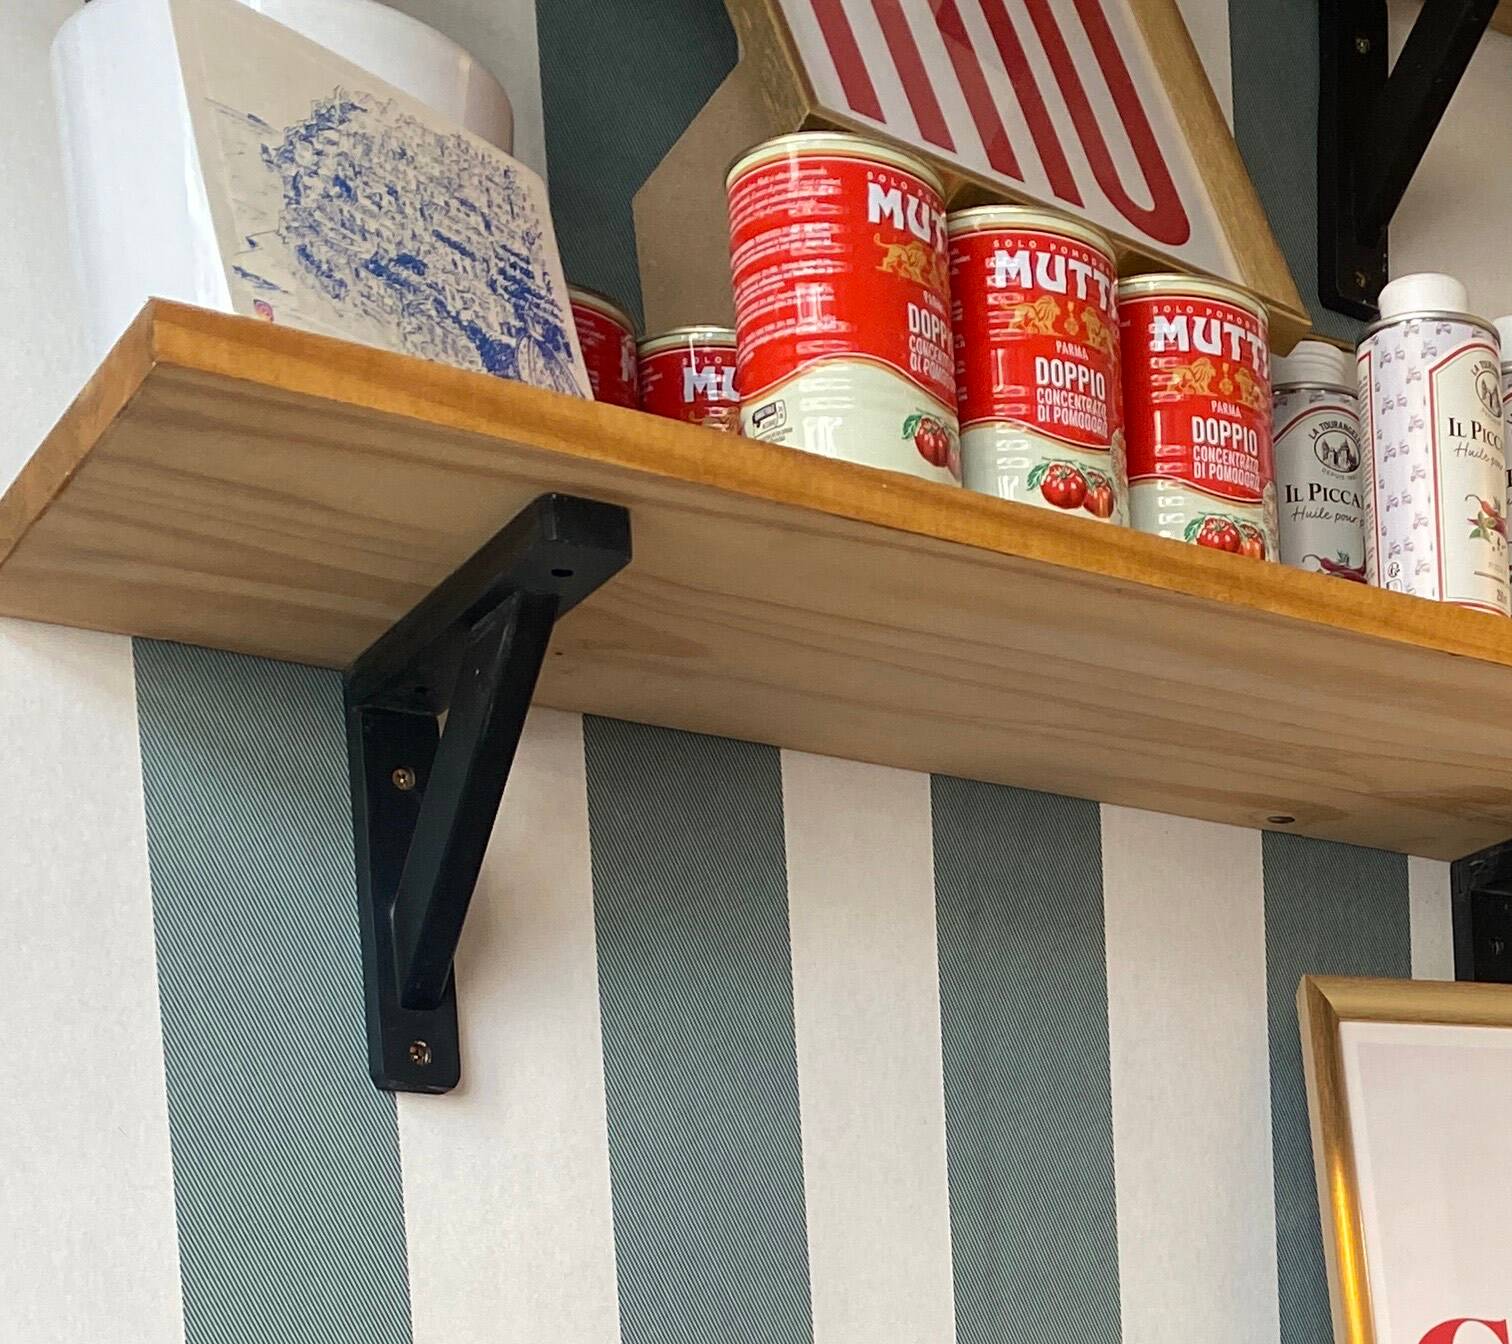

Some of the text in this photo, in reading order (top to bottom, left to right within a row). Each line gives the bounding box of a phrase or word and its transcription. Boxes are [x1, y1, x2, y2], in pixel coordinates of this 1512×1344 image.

[867, 181, 949, 256] MUT
[993, 239, 1037, 249] SOLO
[1152, 304, 1194, 315] SOLO
[1055, 340, 1089, 361] PARMA
[1034, 356, 1107, 401] DOPPIO
[1036, 387, 1107, 421] CONCENTRATO
[1210, 400, 1242, 419] PARMA
[1037, 406, 1108, 440] DI POMODORO
[1308, 428, 1320, 440] LA
[1191, 416, 1259, 459] DOPPIO
[1192, 445, 1259, 474] CONCENTRATO
[1193, 462, 1206, 479] DI
